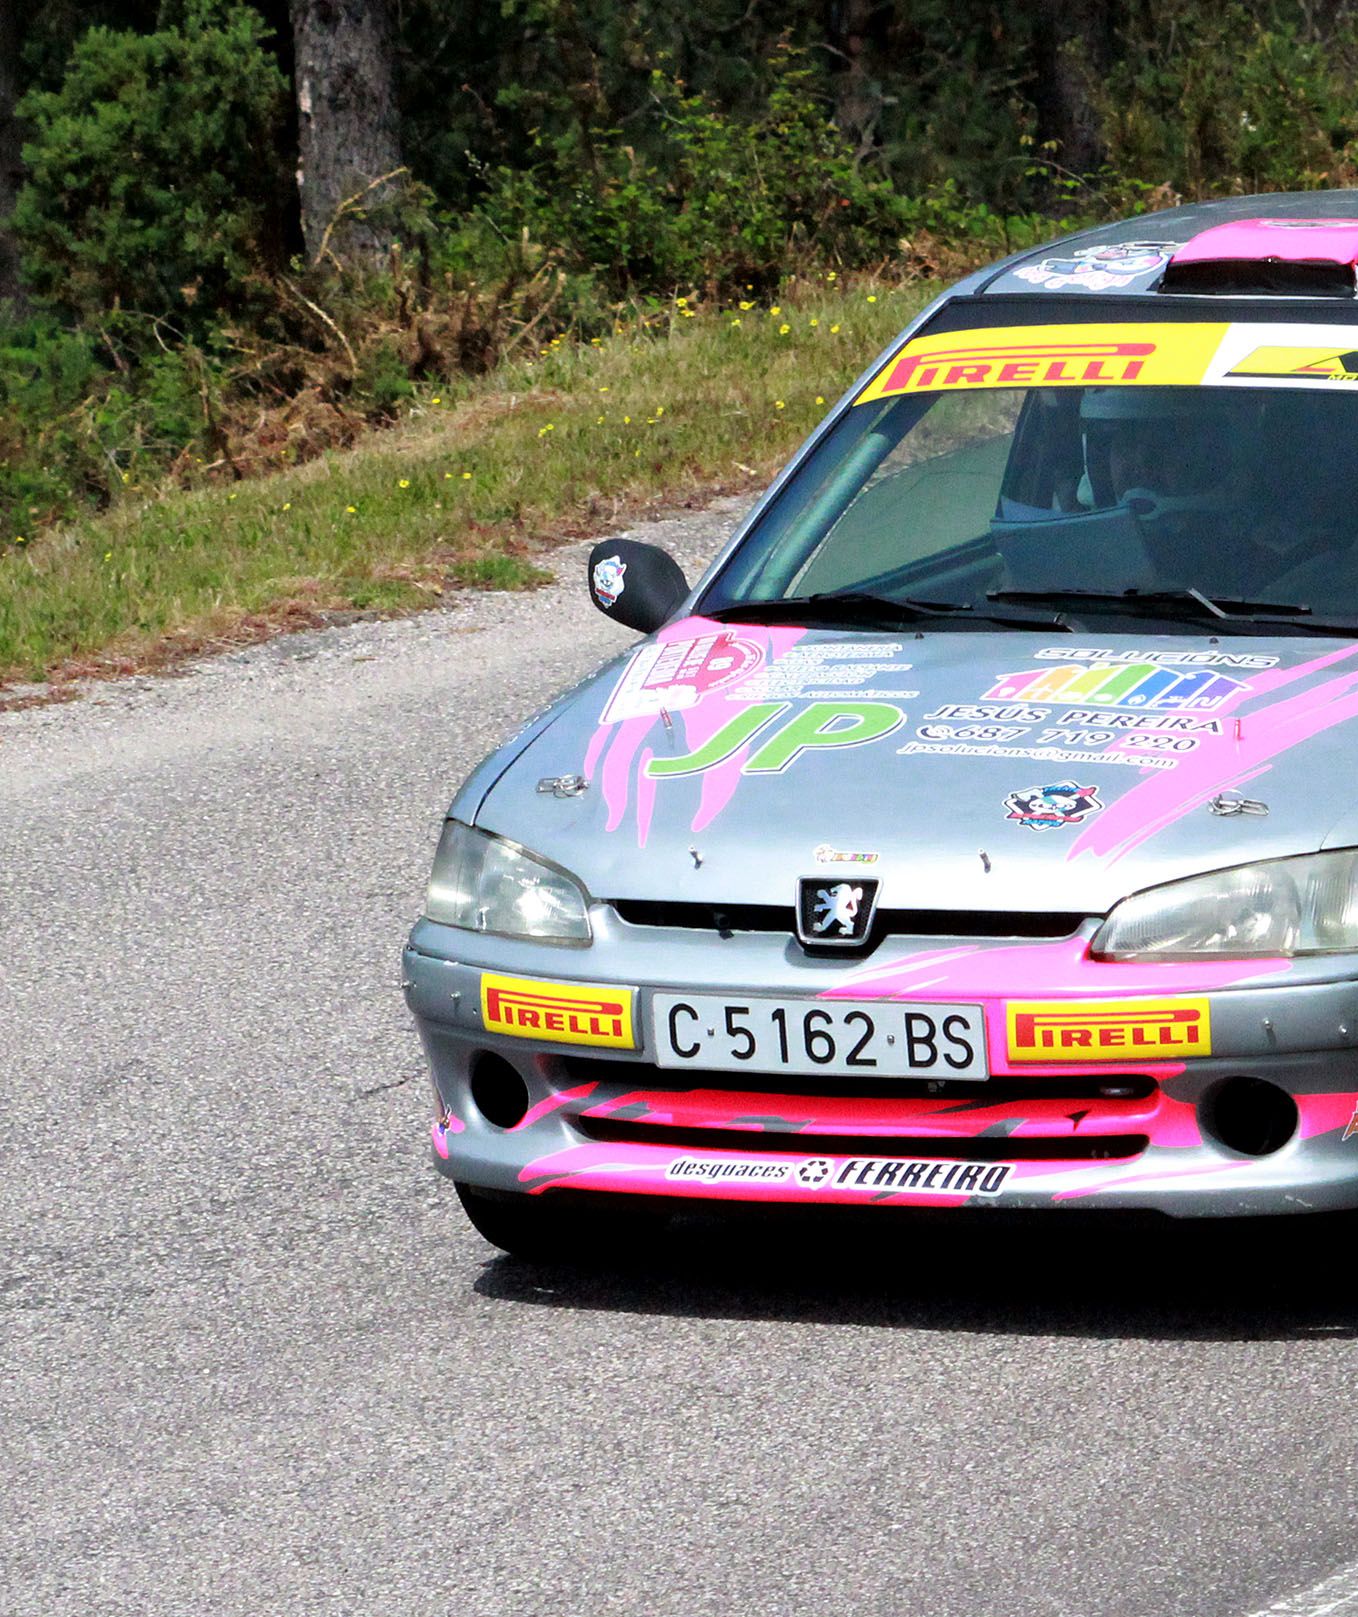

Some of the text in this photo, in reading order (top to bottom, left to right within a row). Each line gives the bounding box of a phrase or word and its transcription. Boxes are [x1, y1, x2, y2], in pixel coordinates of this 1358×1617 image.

[883, 344, 1156, 391] PIRELLI
[648, 702, 903, 774] JP
[928, 705, 1222, 735] JESÚS PEREIRA
[955, 727, 1198, 751] 687 719 220
[486, 988, 623, 1038] PIRELLI
[1016, 1009, 1200, 1048] PIRELLI
[670, 1160, 1011, 1192] desguaces FERREIRO
